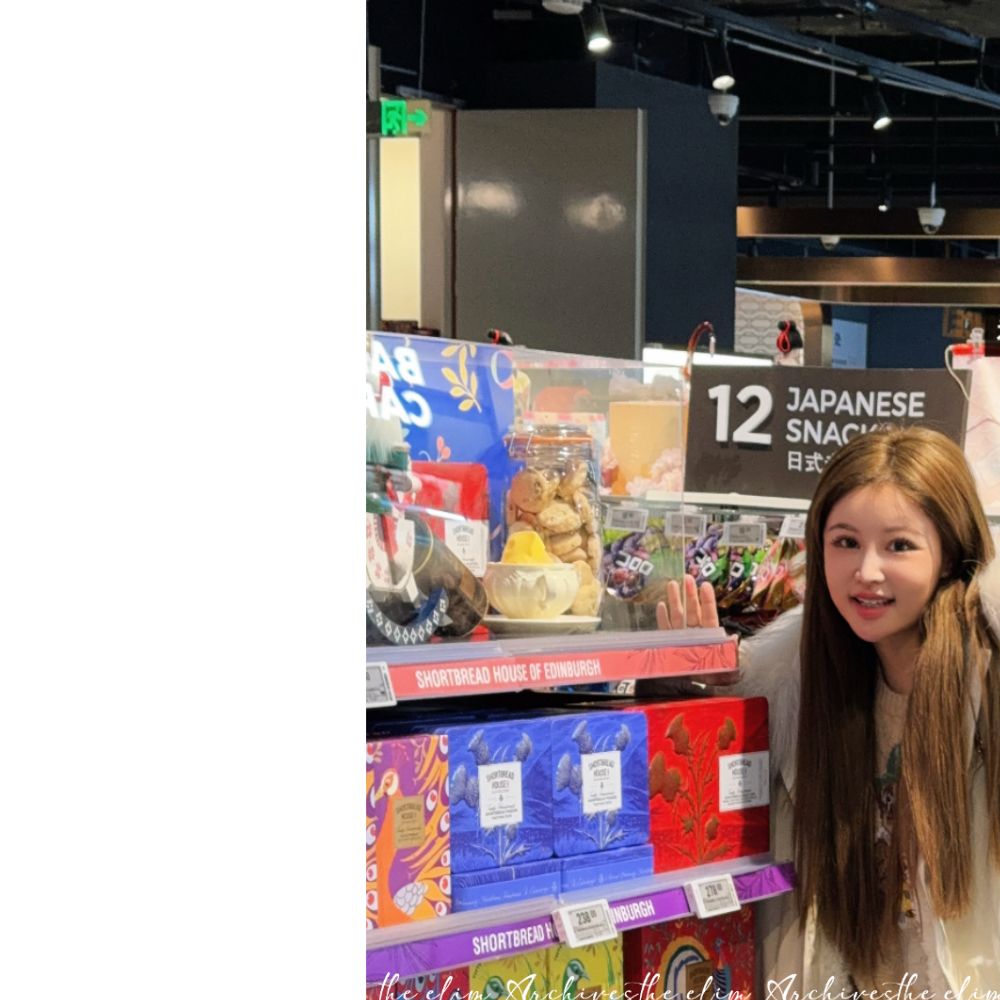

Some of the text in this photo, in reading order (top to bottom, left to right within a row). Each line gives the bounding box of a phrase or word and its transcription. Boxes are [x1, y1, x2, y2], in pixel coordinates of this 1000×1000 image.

[708, 384, 773, 445] 12
[786, 386, 925, 418] JAPANESE
[785, 419, 884, 446] SNAC
[787, 451, 833, 473] 日式
[415, 658, 601, 689] SHORTBREAD HOUSE OF EDINBURGH
[609, 900, 656, 925] INBURGH
[472, 925, 545, 955] SHORTBREAD
